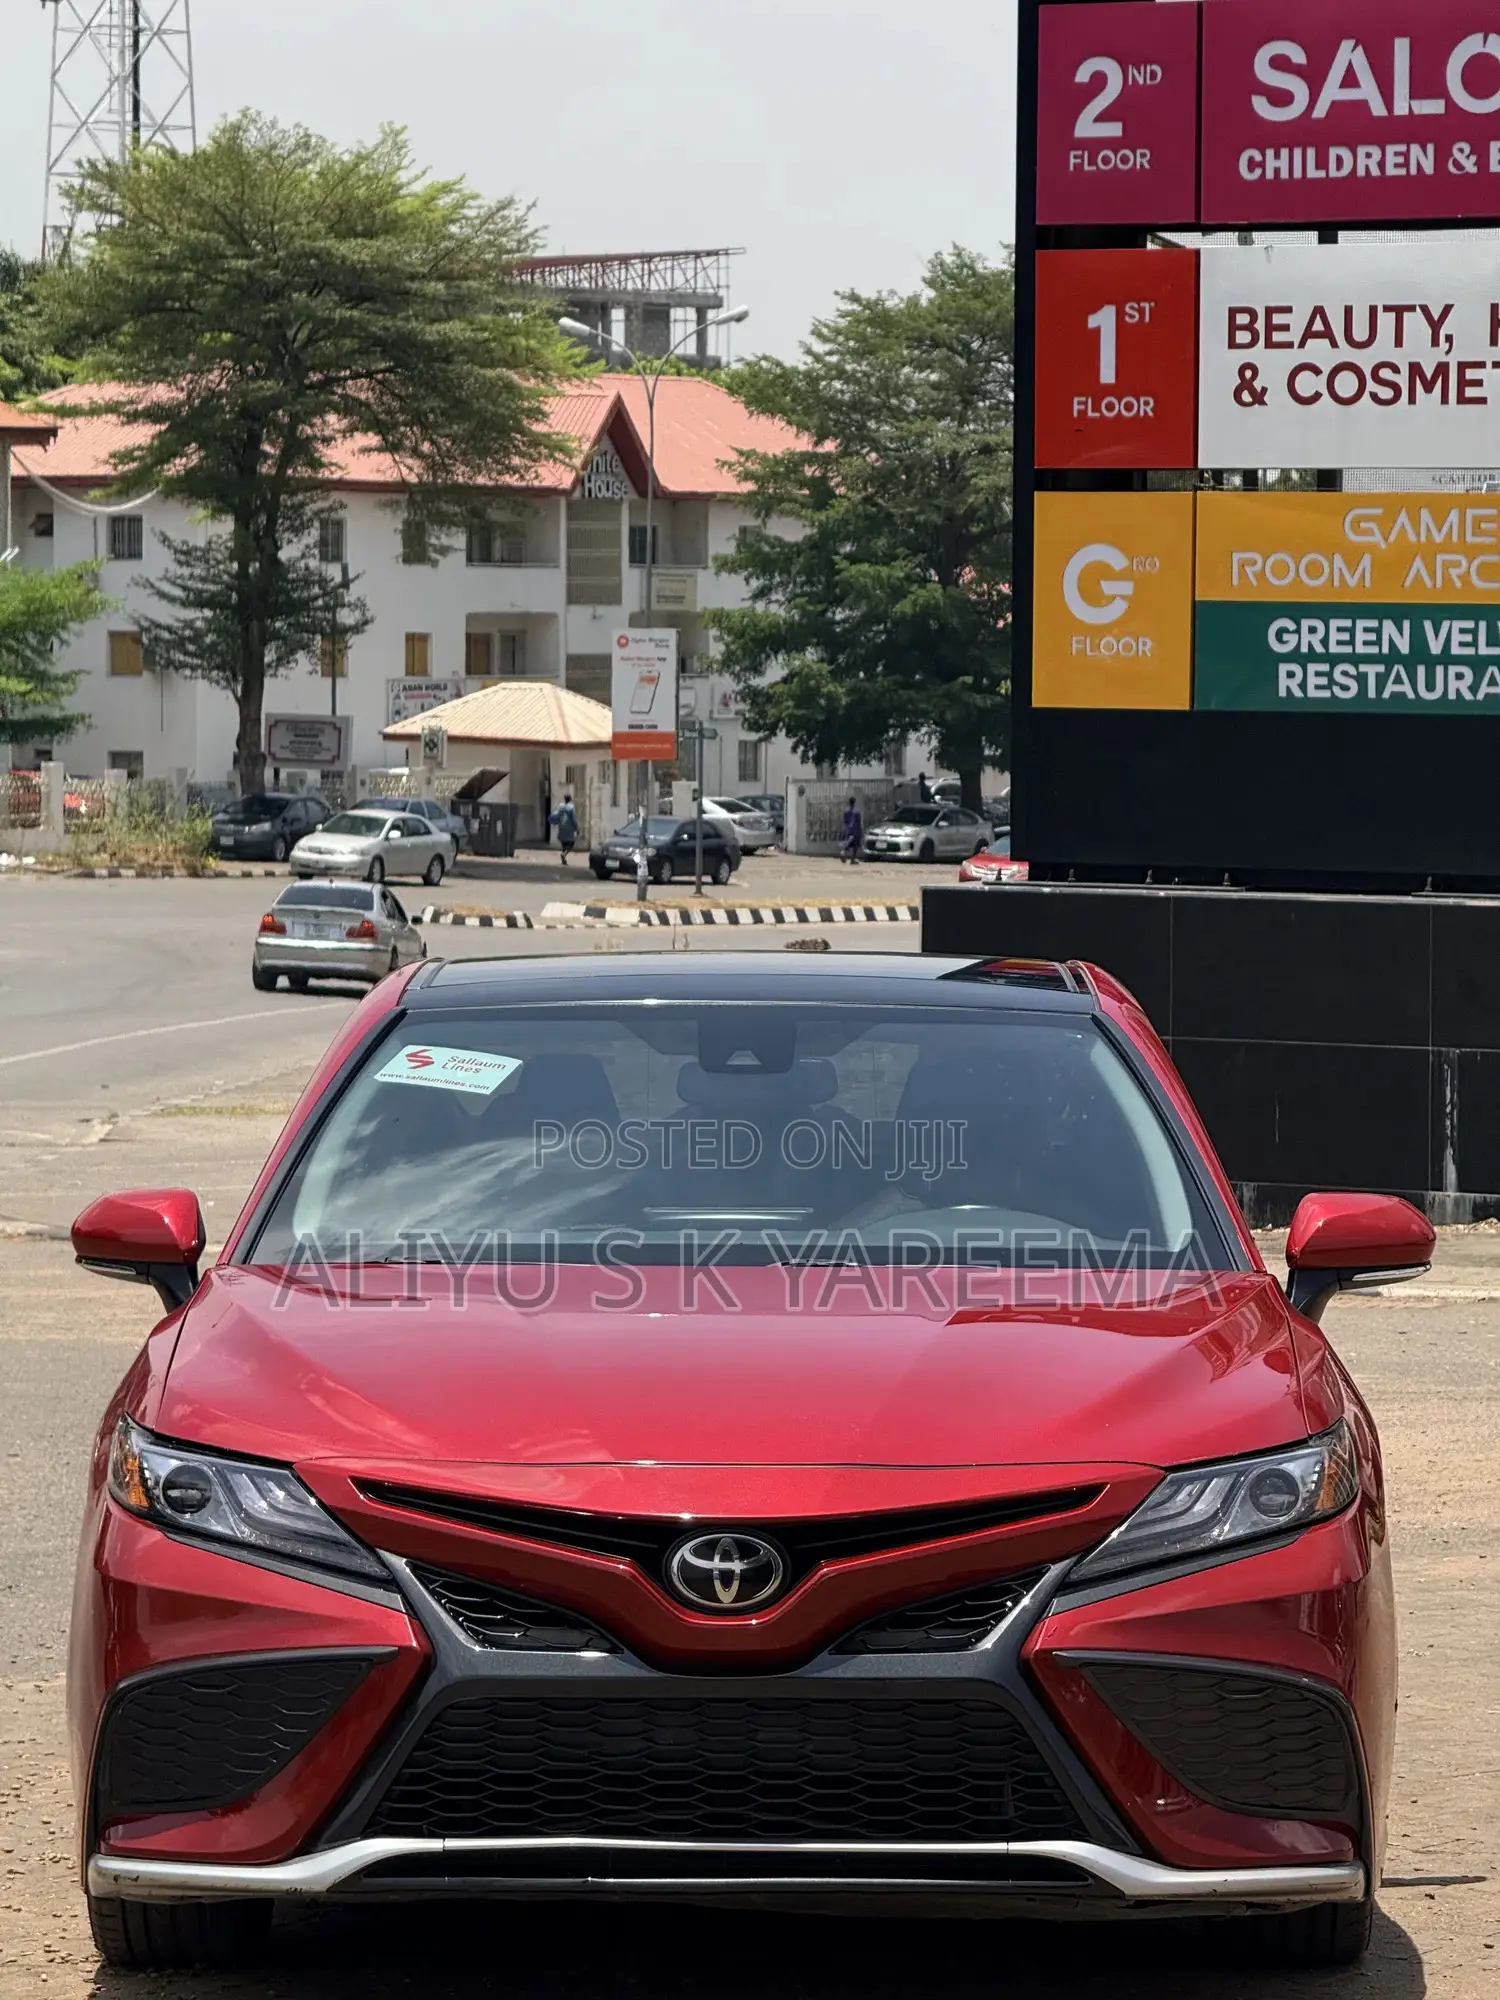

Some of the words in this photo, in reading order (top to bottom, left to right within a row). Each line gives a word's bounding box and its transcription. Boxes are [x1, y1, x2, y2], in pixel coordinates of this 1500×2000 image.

[1069, 149, 1151, 172] FLOOR
[1238, 142, 1435, 181] CHILDREN
[1447, 141, 1478, 175] &
[1227, 303, 1455, 356] BEAUTY,
[1233, 361, 1268, 408] &
[1073, 396, 1154, 418] FLOOR
[584, 471, 629, 499] House
[1343, 507, 1499, 548] GAME
[1231, 551, 1372, 589] ROOM
[1071, 635, 1152, 657] FLOOR
[1267, 617, 1411, 655] GREEN
[1423, 619, 1500, 656] VEL
[1277, 663, 1500, 701] RESTAURA
[441, 1062, 482, 1074] Lines
[447, 1055, 507, 1070] Sallaum
